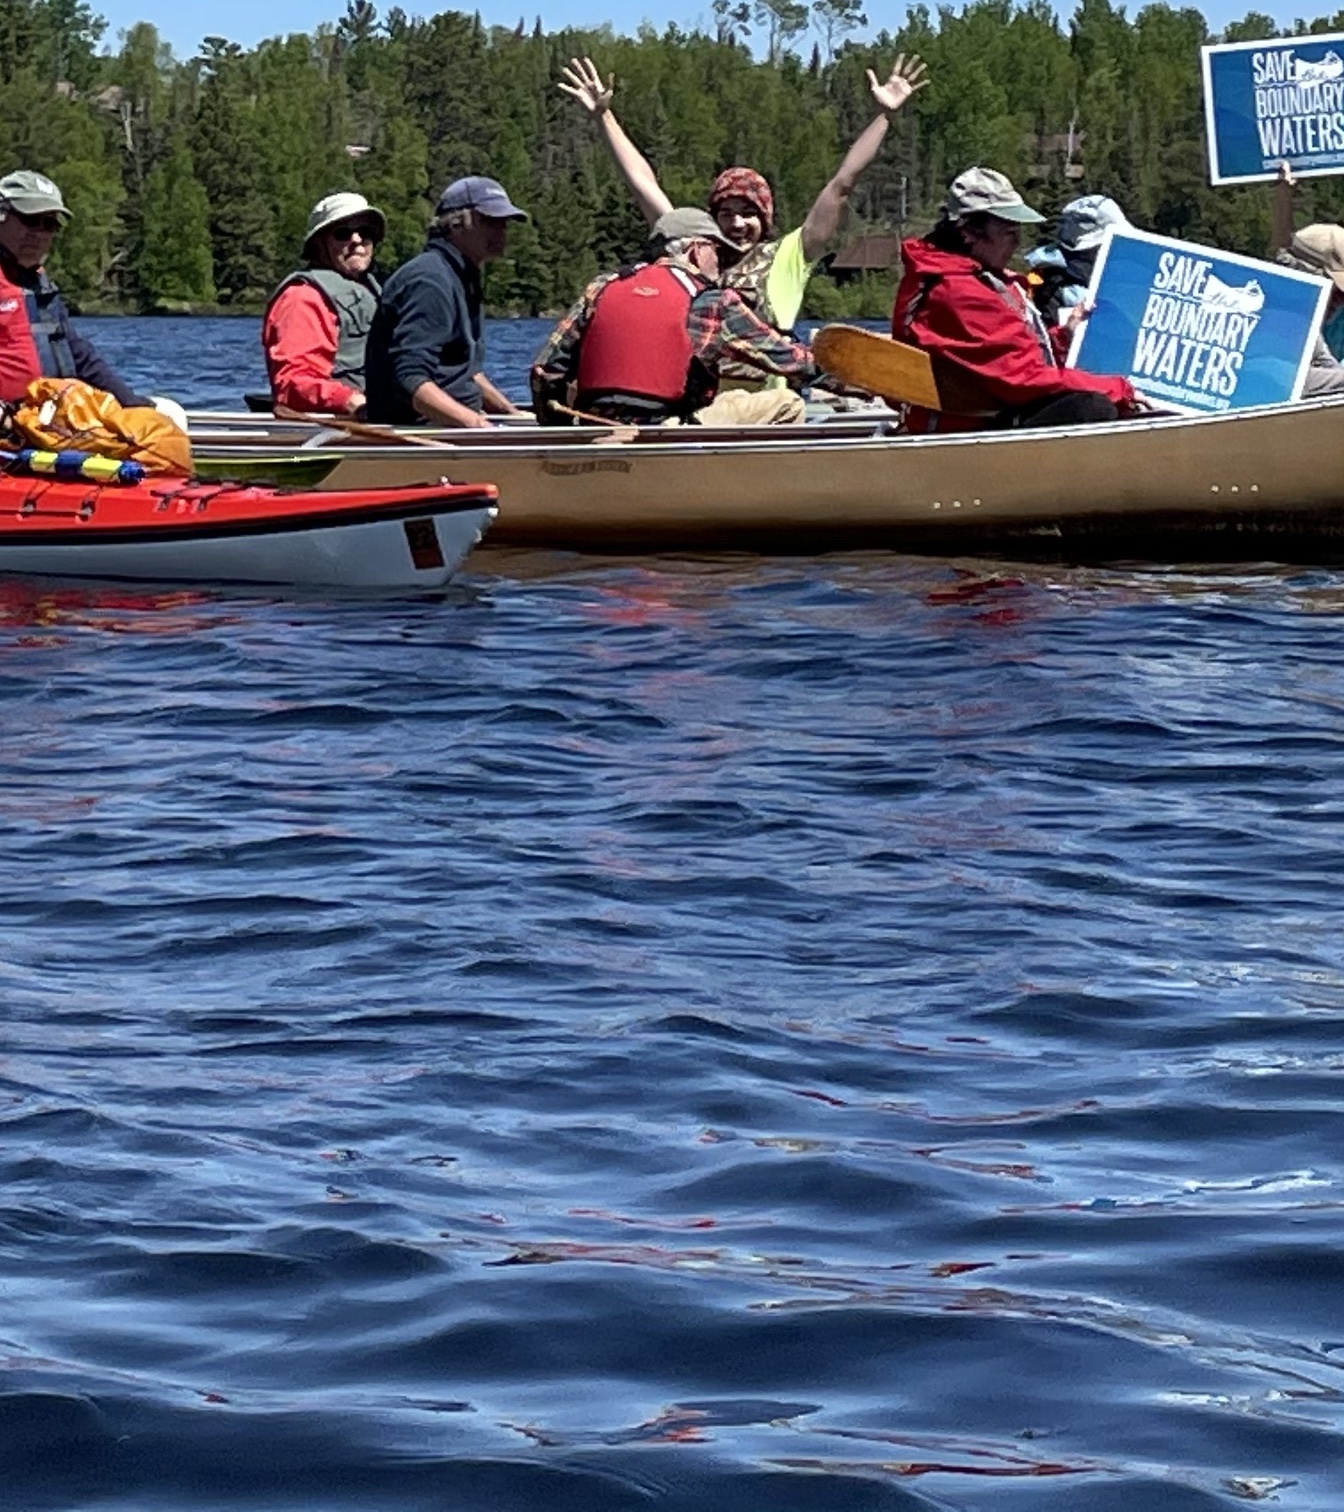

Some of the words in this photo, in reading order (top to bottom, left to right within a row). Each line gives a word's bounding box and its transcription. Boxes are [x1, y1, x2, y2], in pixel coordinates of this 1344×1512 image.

[1252, 49, 1295, 84] SAVE
[1255, 82, 1344, 118] BOUNDARY
[1154, 251, 1213, 298] SAVE
[1141, 293, 1258, 353] BOUNDARY
[1132, 328, 1242, 395] WATERS
